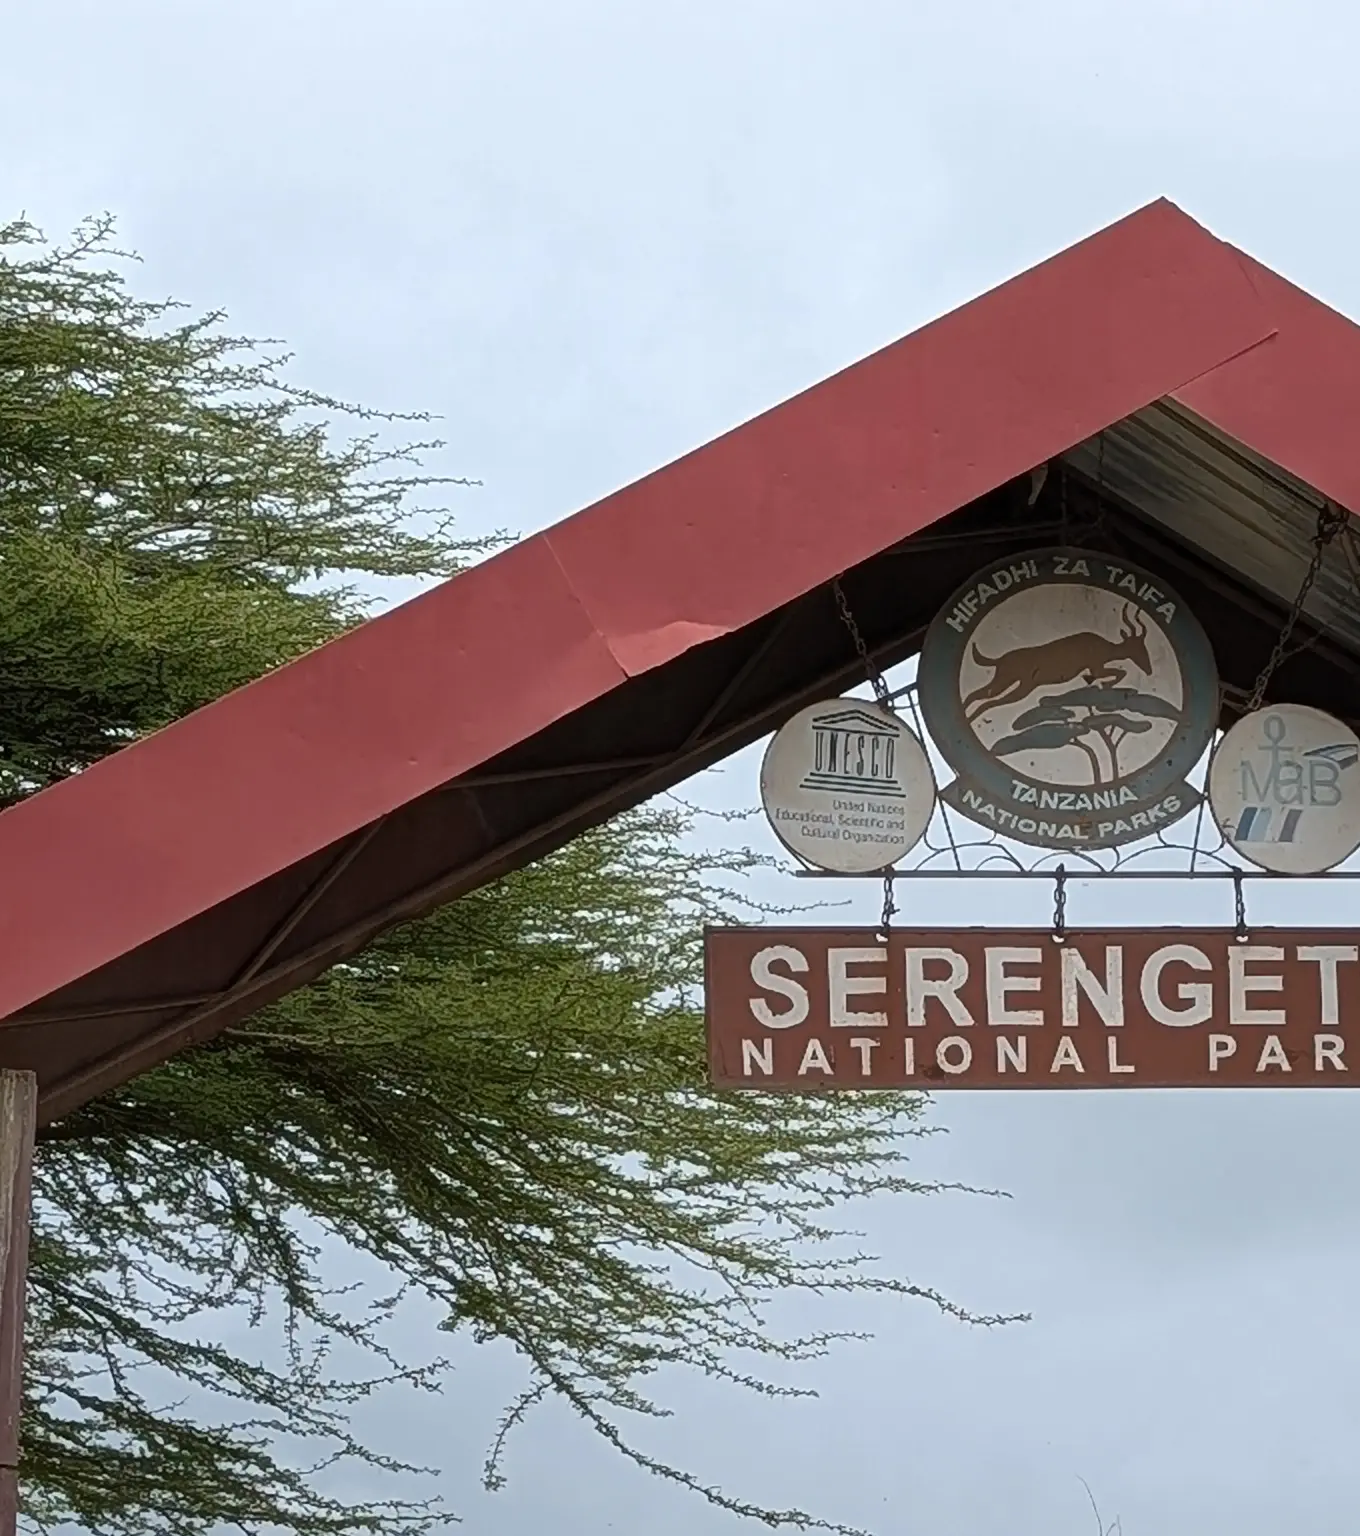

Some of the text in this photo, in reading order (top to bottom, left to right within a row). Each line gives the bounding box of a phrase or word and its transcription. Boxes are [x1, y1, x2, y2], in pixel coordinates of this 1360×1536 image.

[945, 556, 1177, 633] HIFADHI ZA TAIFA
[814, 731, 895, 779] UNESCO
[961, 790, 1182, 840] NATIONAL PARKS
[1011, 779, 1139, 811] TANZANIA
[741, 1034, 1136, 1076] NATIONAL
